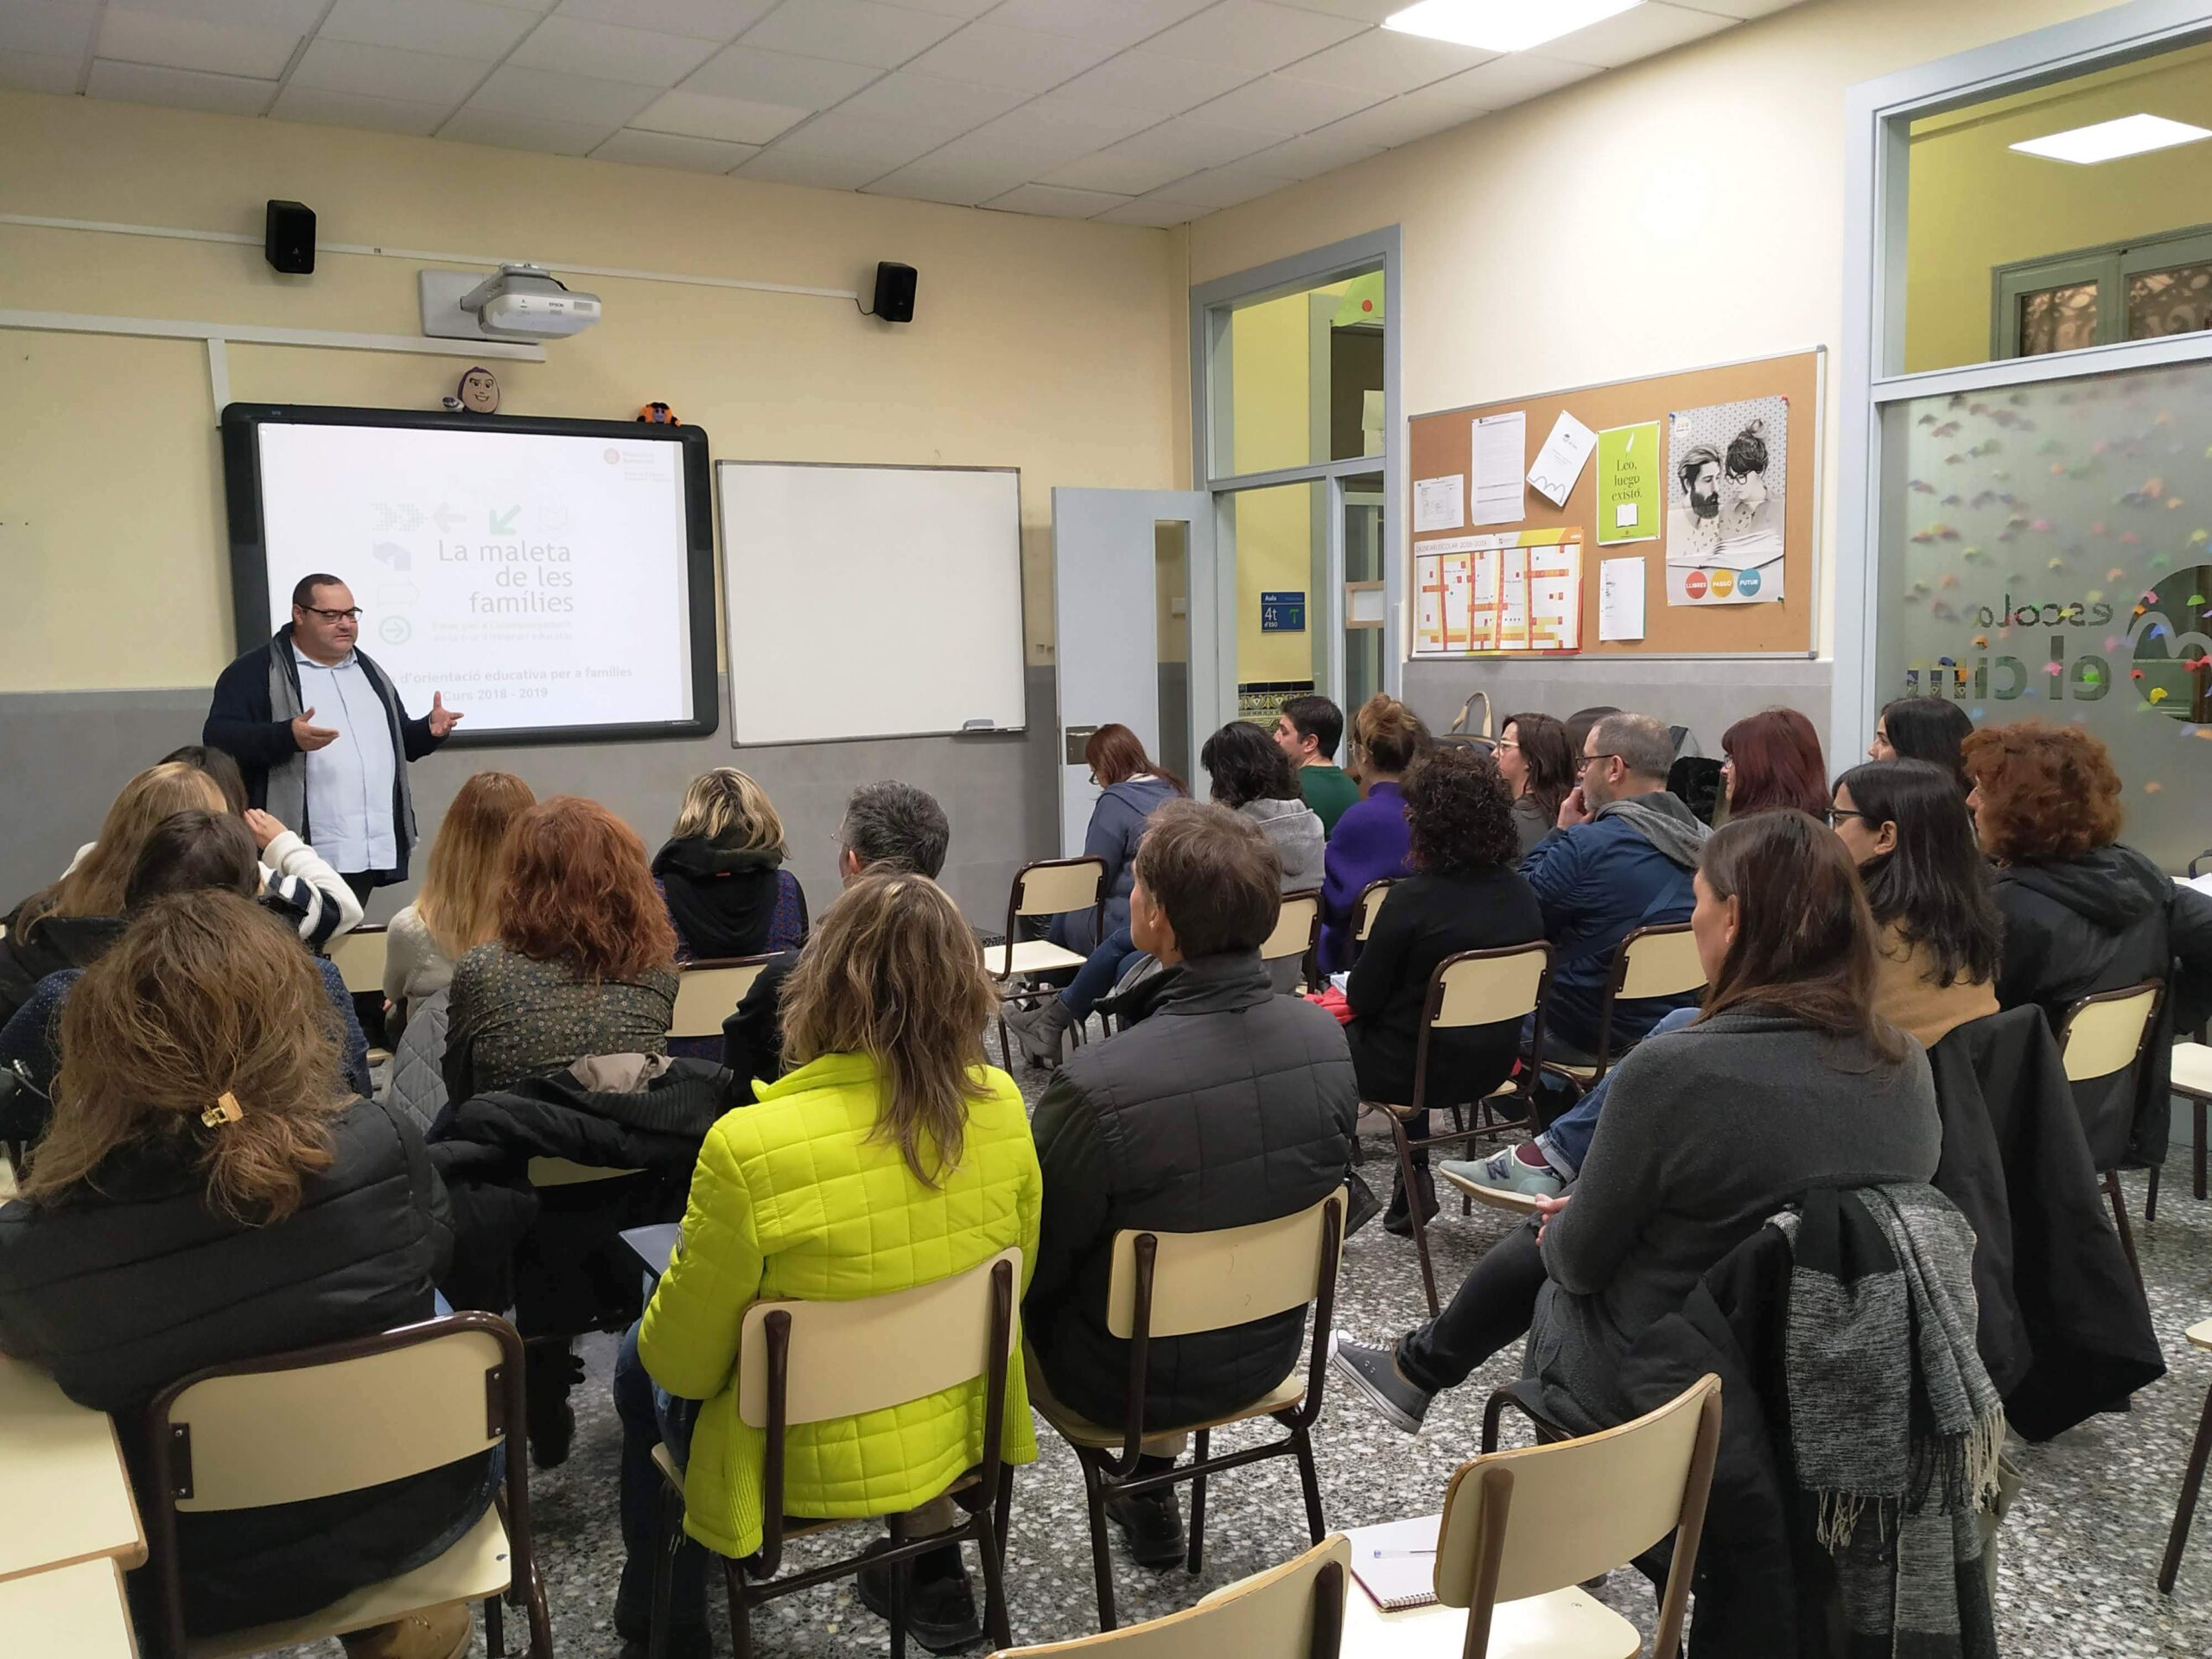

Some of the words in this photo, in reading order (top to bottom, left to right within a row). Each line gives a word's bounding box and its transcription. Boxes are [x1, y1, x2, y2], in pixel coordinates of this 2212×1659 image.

[1617, 460, 1637, 471] Leo,
[1614, 474, 1640, 488] luego
[438, 539, 468, 562] La
[480, 540, 571, 562] maleta
[495, 566, 527, 587] de
[538, 566, 573, 587] les
[469, 590, 574, 613] famílies
[1264, 607, 1278, 620] 4t
[400, 671, 481, 683] d'orientació
[485, 669, 546, 681] educativa
[551, 670, 570, 681] per
[442, 691, 474, 701] Curs
[478, 689, 507, 700] 2018
[519, 687, 548, 698] 2019
[1486, 1159, 1510, 1180] N
